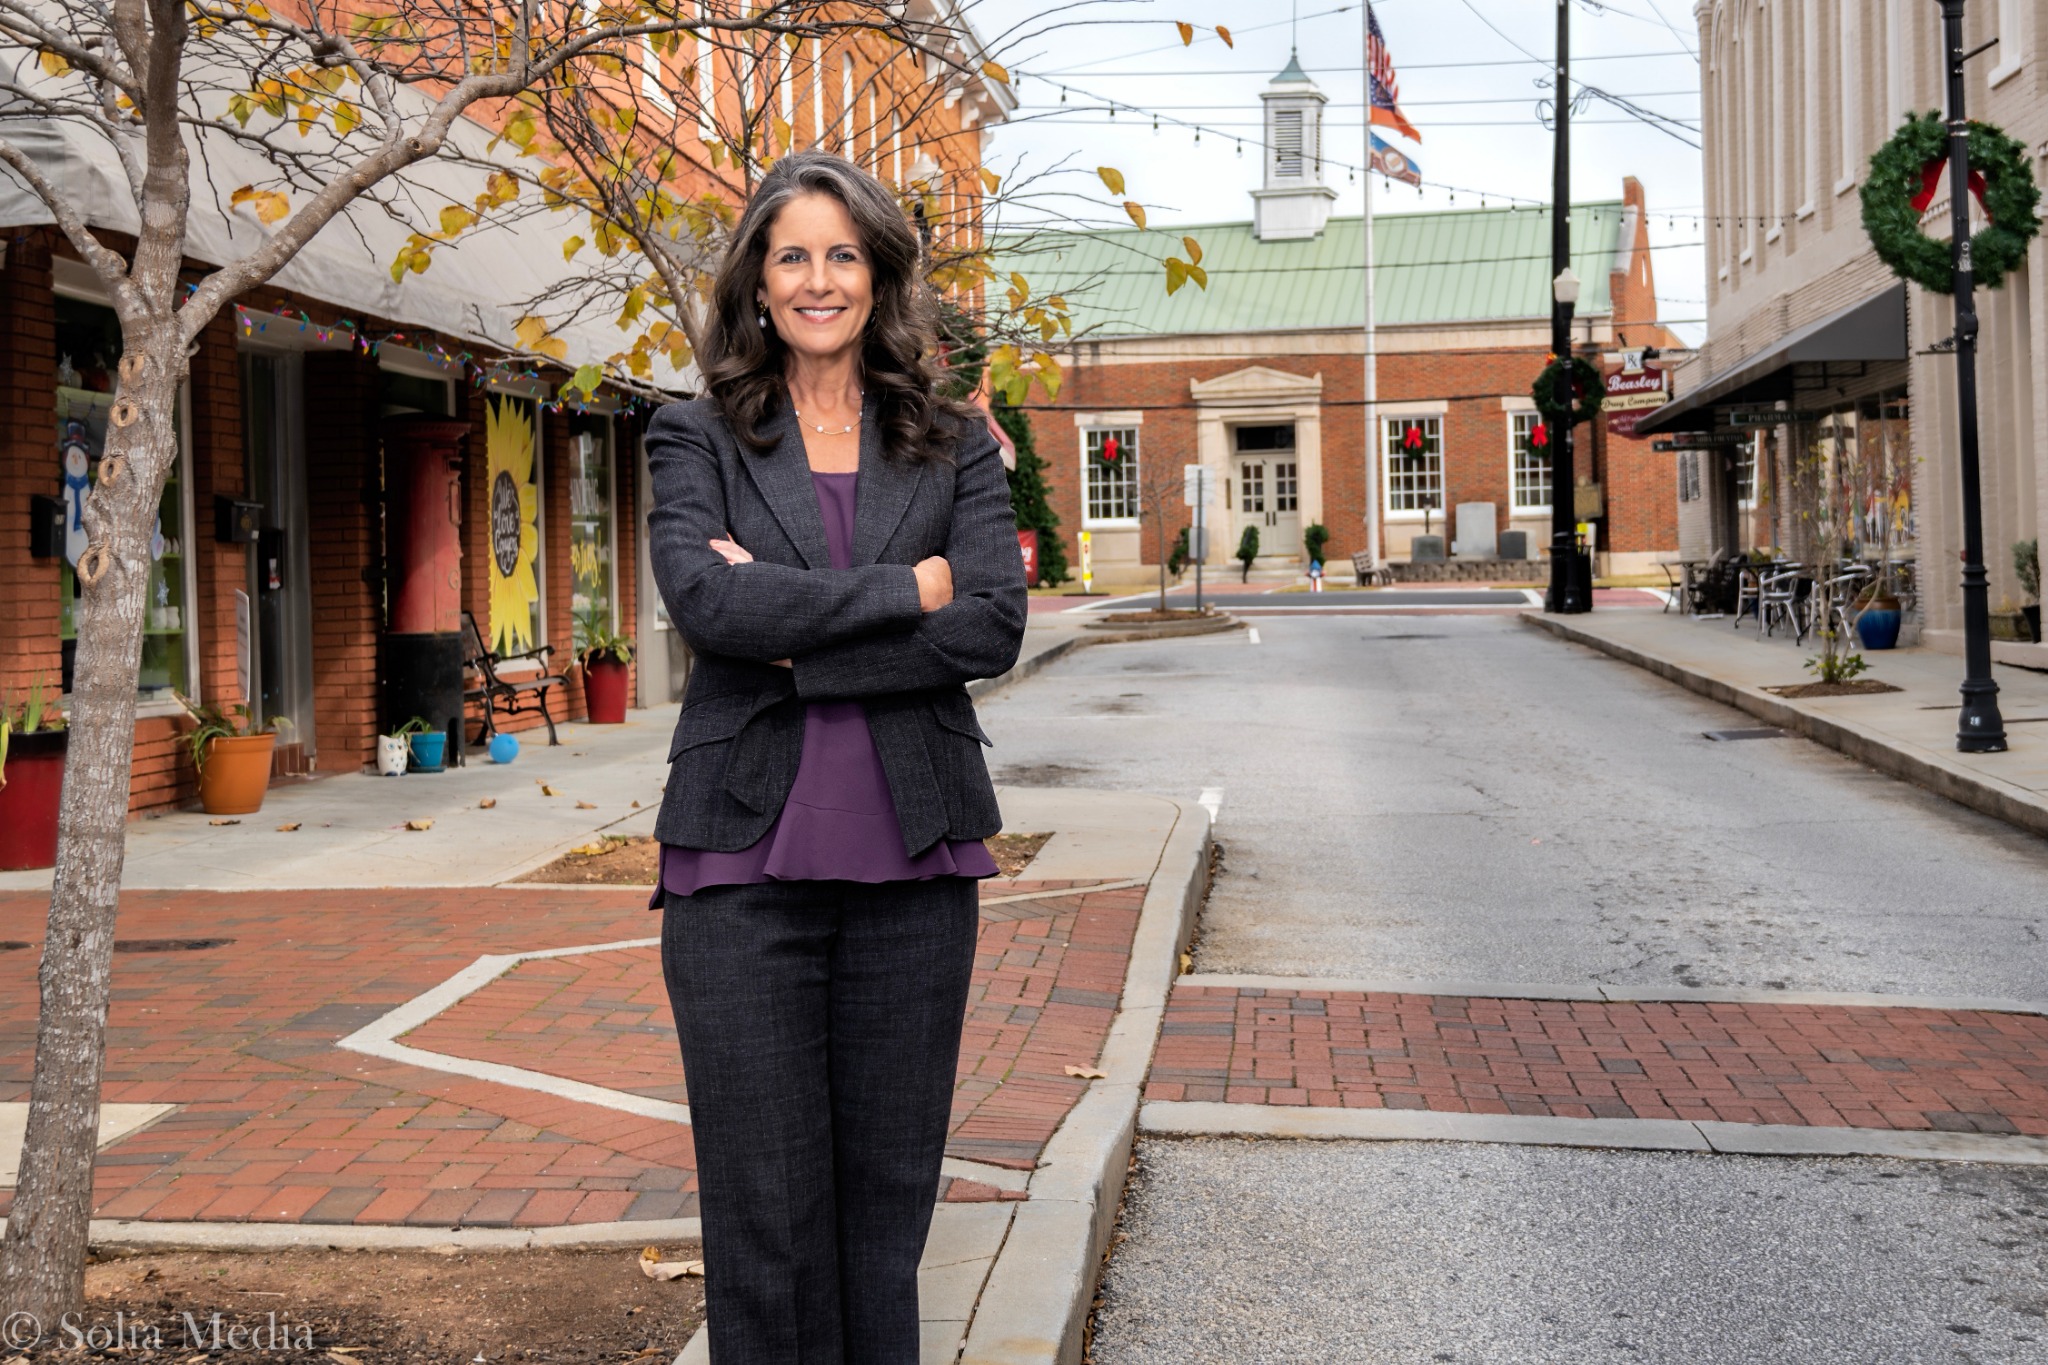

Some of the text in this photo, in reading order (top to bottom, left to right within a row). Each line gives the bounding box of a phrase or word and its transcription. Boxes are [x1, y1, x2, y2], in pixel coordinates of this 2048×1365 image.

[1607, 374, 1660, 391] Beasley
[1601, 395, 1666, 409] Drug Company
[1749, 413, 1797, 422] PHARMACY
